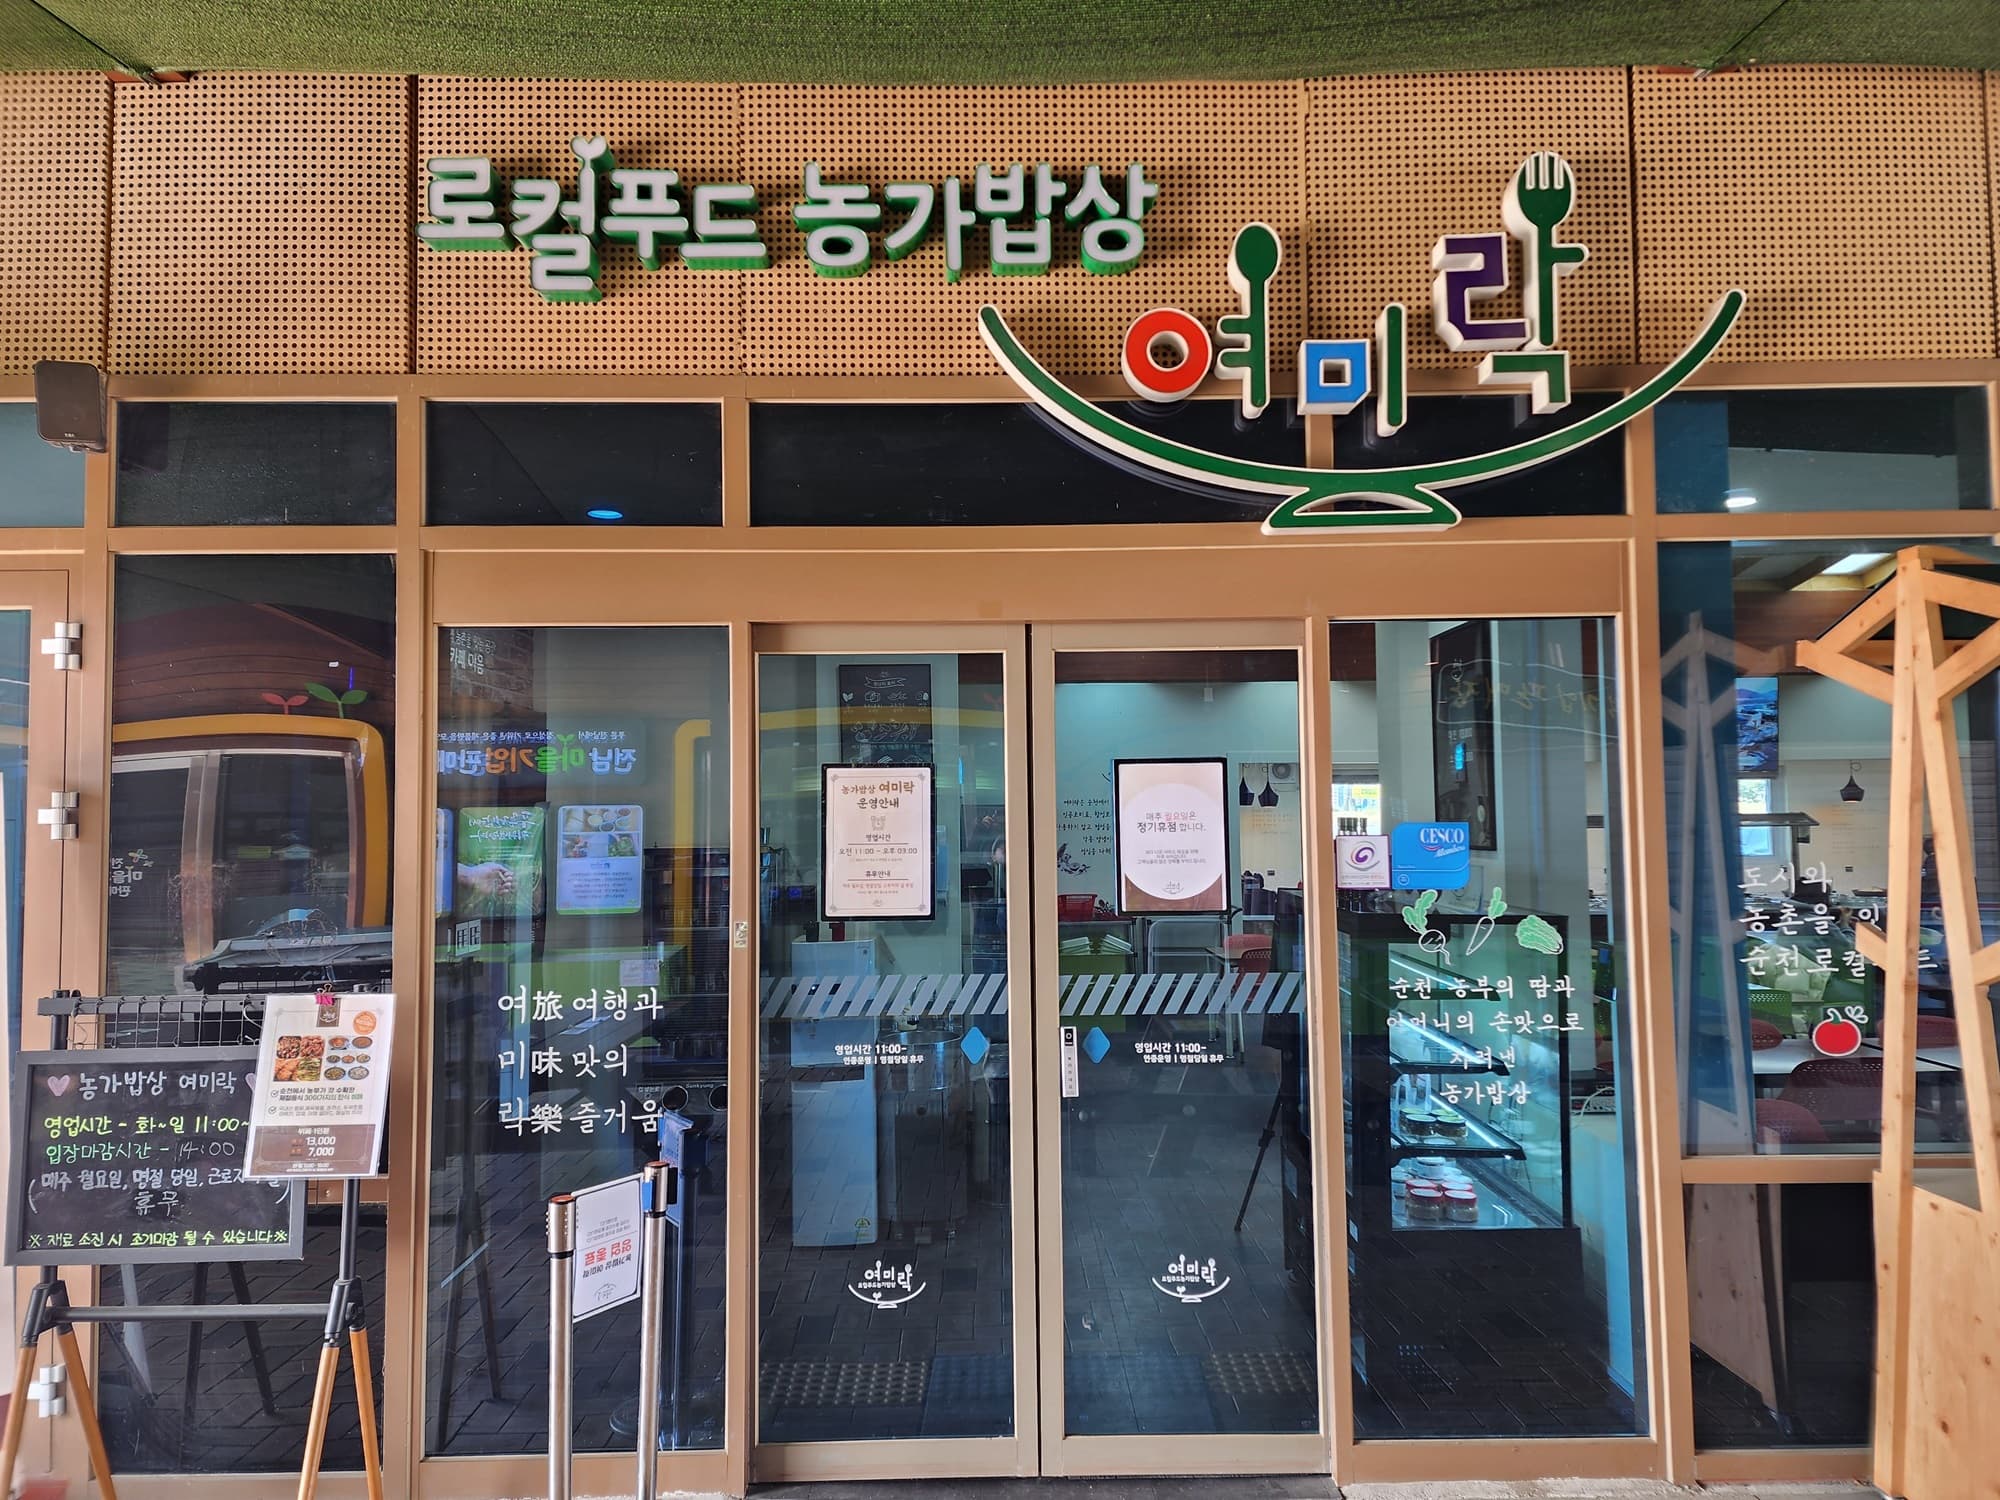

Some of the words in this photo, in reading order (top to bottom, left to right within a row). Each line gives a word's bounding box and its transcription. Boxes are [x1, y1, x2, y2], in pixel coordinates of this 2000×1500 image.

[416, 136, 771, 301] 로컬푸드
[792, 160, 1159, 282] 농가밥상
[1122, 150, 1589, 437] 여미락
[841, 784, 876, 795] 농가밥상
[879, 780, 915, 794] 여미락
[857, 797, 900, 810] 운영안내
[1420, 827, 1465, 844] CESCO
[1737, 862, 1833, 893] 도시와
[1739, 903, 1836, 936] 농촌을
[1389, 977, 1432, 999] 순천
[1448, 975, 1514, 999] 농부의
[1529, 975, 1576, 999] 땀과
[498, 985, 564, 1024] 여旅
[572, 986, 664, 1022] 여행과
[1386, 1011, 1474, 1034] 어머니의
[1489, 1011, 1585, 1034] 손맛으로
[835, 1044, 872, 1055] 영업시간
[909, 1055, 924, 1064] 휴무
[1134, 1042, 1172, 1054] 영업시간
[1208, 1054, 1224, 1062] 휴무
[498, 1041, 564, 1080] 미味
[572, 1043, 629, 1078] 맛의
[79, 1073, 167, 1101] 농가밥상
[179, 1071, 237, 1094] 여미락
[1440, 1081, 1532, 1105] 농가밥상
[44, 1116, 113, 1138] 영업시간
[135, 1114, 185, 1136] 화~일
[498, 1097, 563, 1136] 락樂
[570, 1099, 664, 1134] 즐거움
[305, 1136, 336, 1146] 13,000
[308, 1147, 335, 1157] 7,000
[46, 1142, 152, 1165] 입장마감시간
[132, 1169, 164, 1190] 명절
[47, 1233, 74, 1247] 재료
[78, 1232, 104, 1246] 소진
[107, 1233, 123, 1246] 시
[130, 1231, 178, 1246] 조기마감
[202, 1231, 216, 1245] 수
[610, 1238, 632, 1258] 영업
[864, 1260, 913, 1292] 여미락
[1168, 1254, 1217, 1286] 여미락
